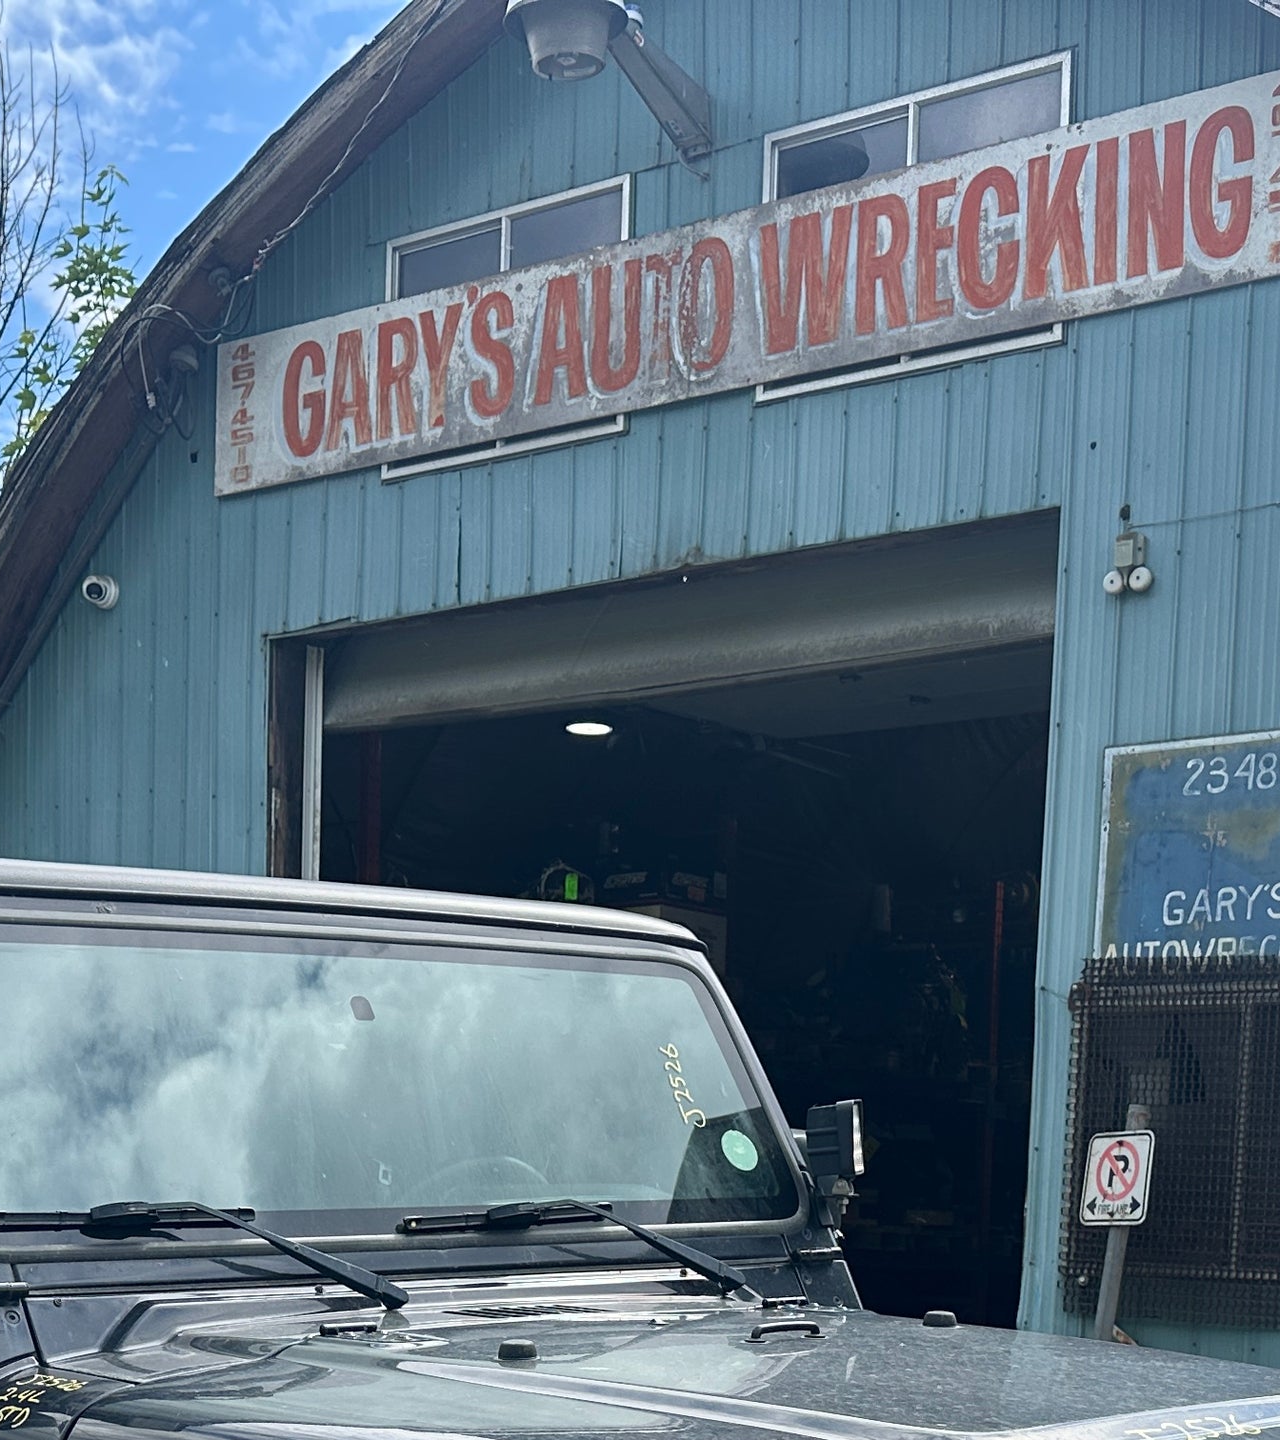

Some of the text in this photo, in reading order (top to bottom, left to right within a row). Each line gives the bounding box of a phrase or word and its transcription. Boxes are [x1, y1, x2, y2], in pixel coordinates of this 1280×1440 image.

[283, 105, 1255, 457] GARY'S AUTO WRECKING
[658, 1043, 706, 1128] J2526
